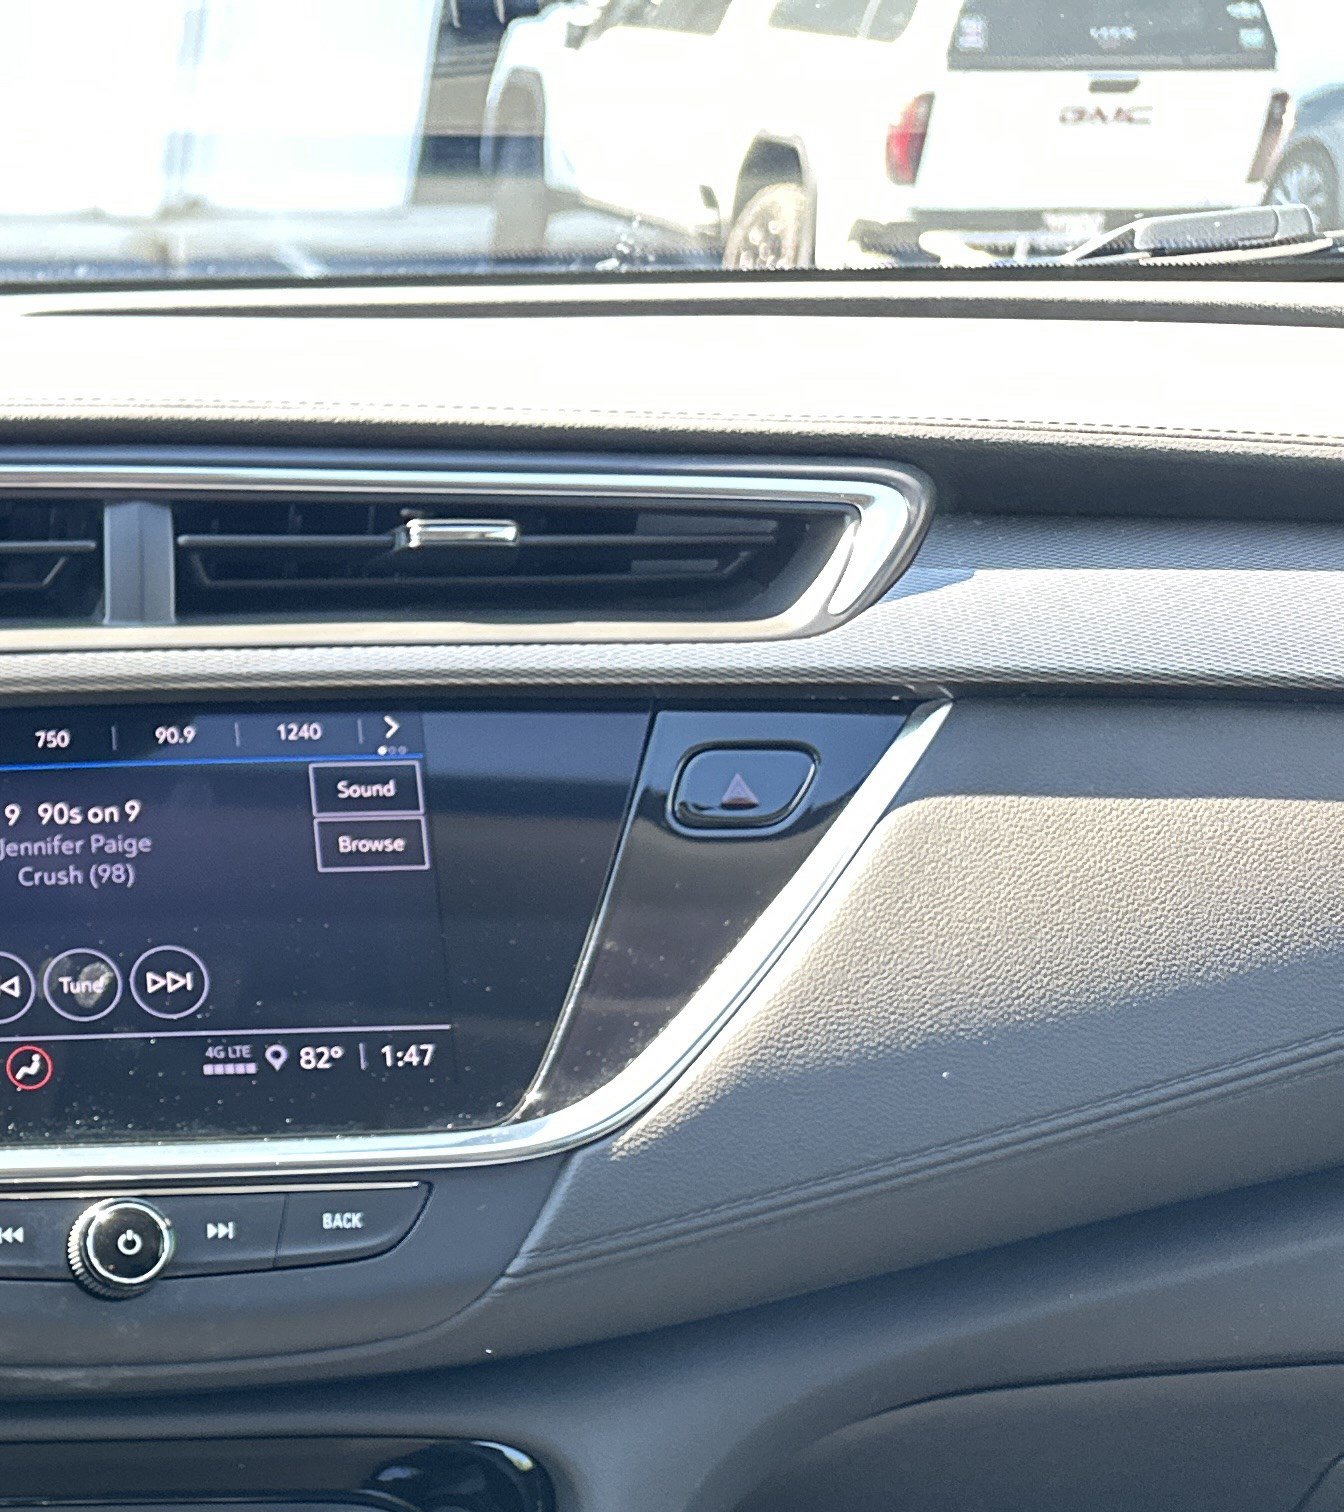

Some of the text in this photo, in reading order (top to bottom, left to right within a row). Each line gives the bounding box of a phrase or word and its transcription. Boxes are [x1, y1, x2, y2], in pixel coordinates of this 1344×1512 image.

[34, 729, 70, 749] 750
[154, 726, 196, 746] 90.9
[277, 721, 322, 742] 1240
[337, 779, 396, 799] Sound
[4, 799, 141, 827] 9 90s on 9
[93, 832, 153, 858] Paige
[338, 834, 406, 854] Browse
[18, 862, 135, 887] Crush (98)
[58, 976, 105, 995] Tune
[206, 1045, 251, 1059] 4G LTE
[299, 1045, 343, 1069] 82°
[381, 1044, 436, 1068] 1:47
[323, 1212, 364, 1230] BACK
